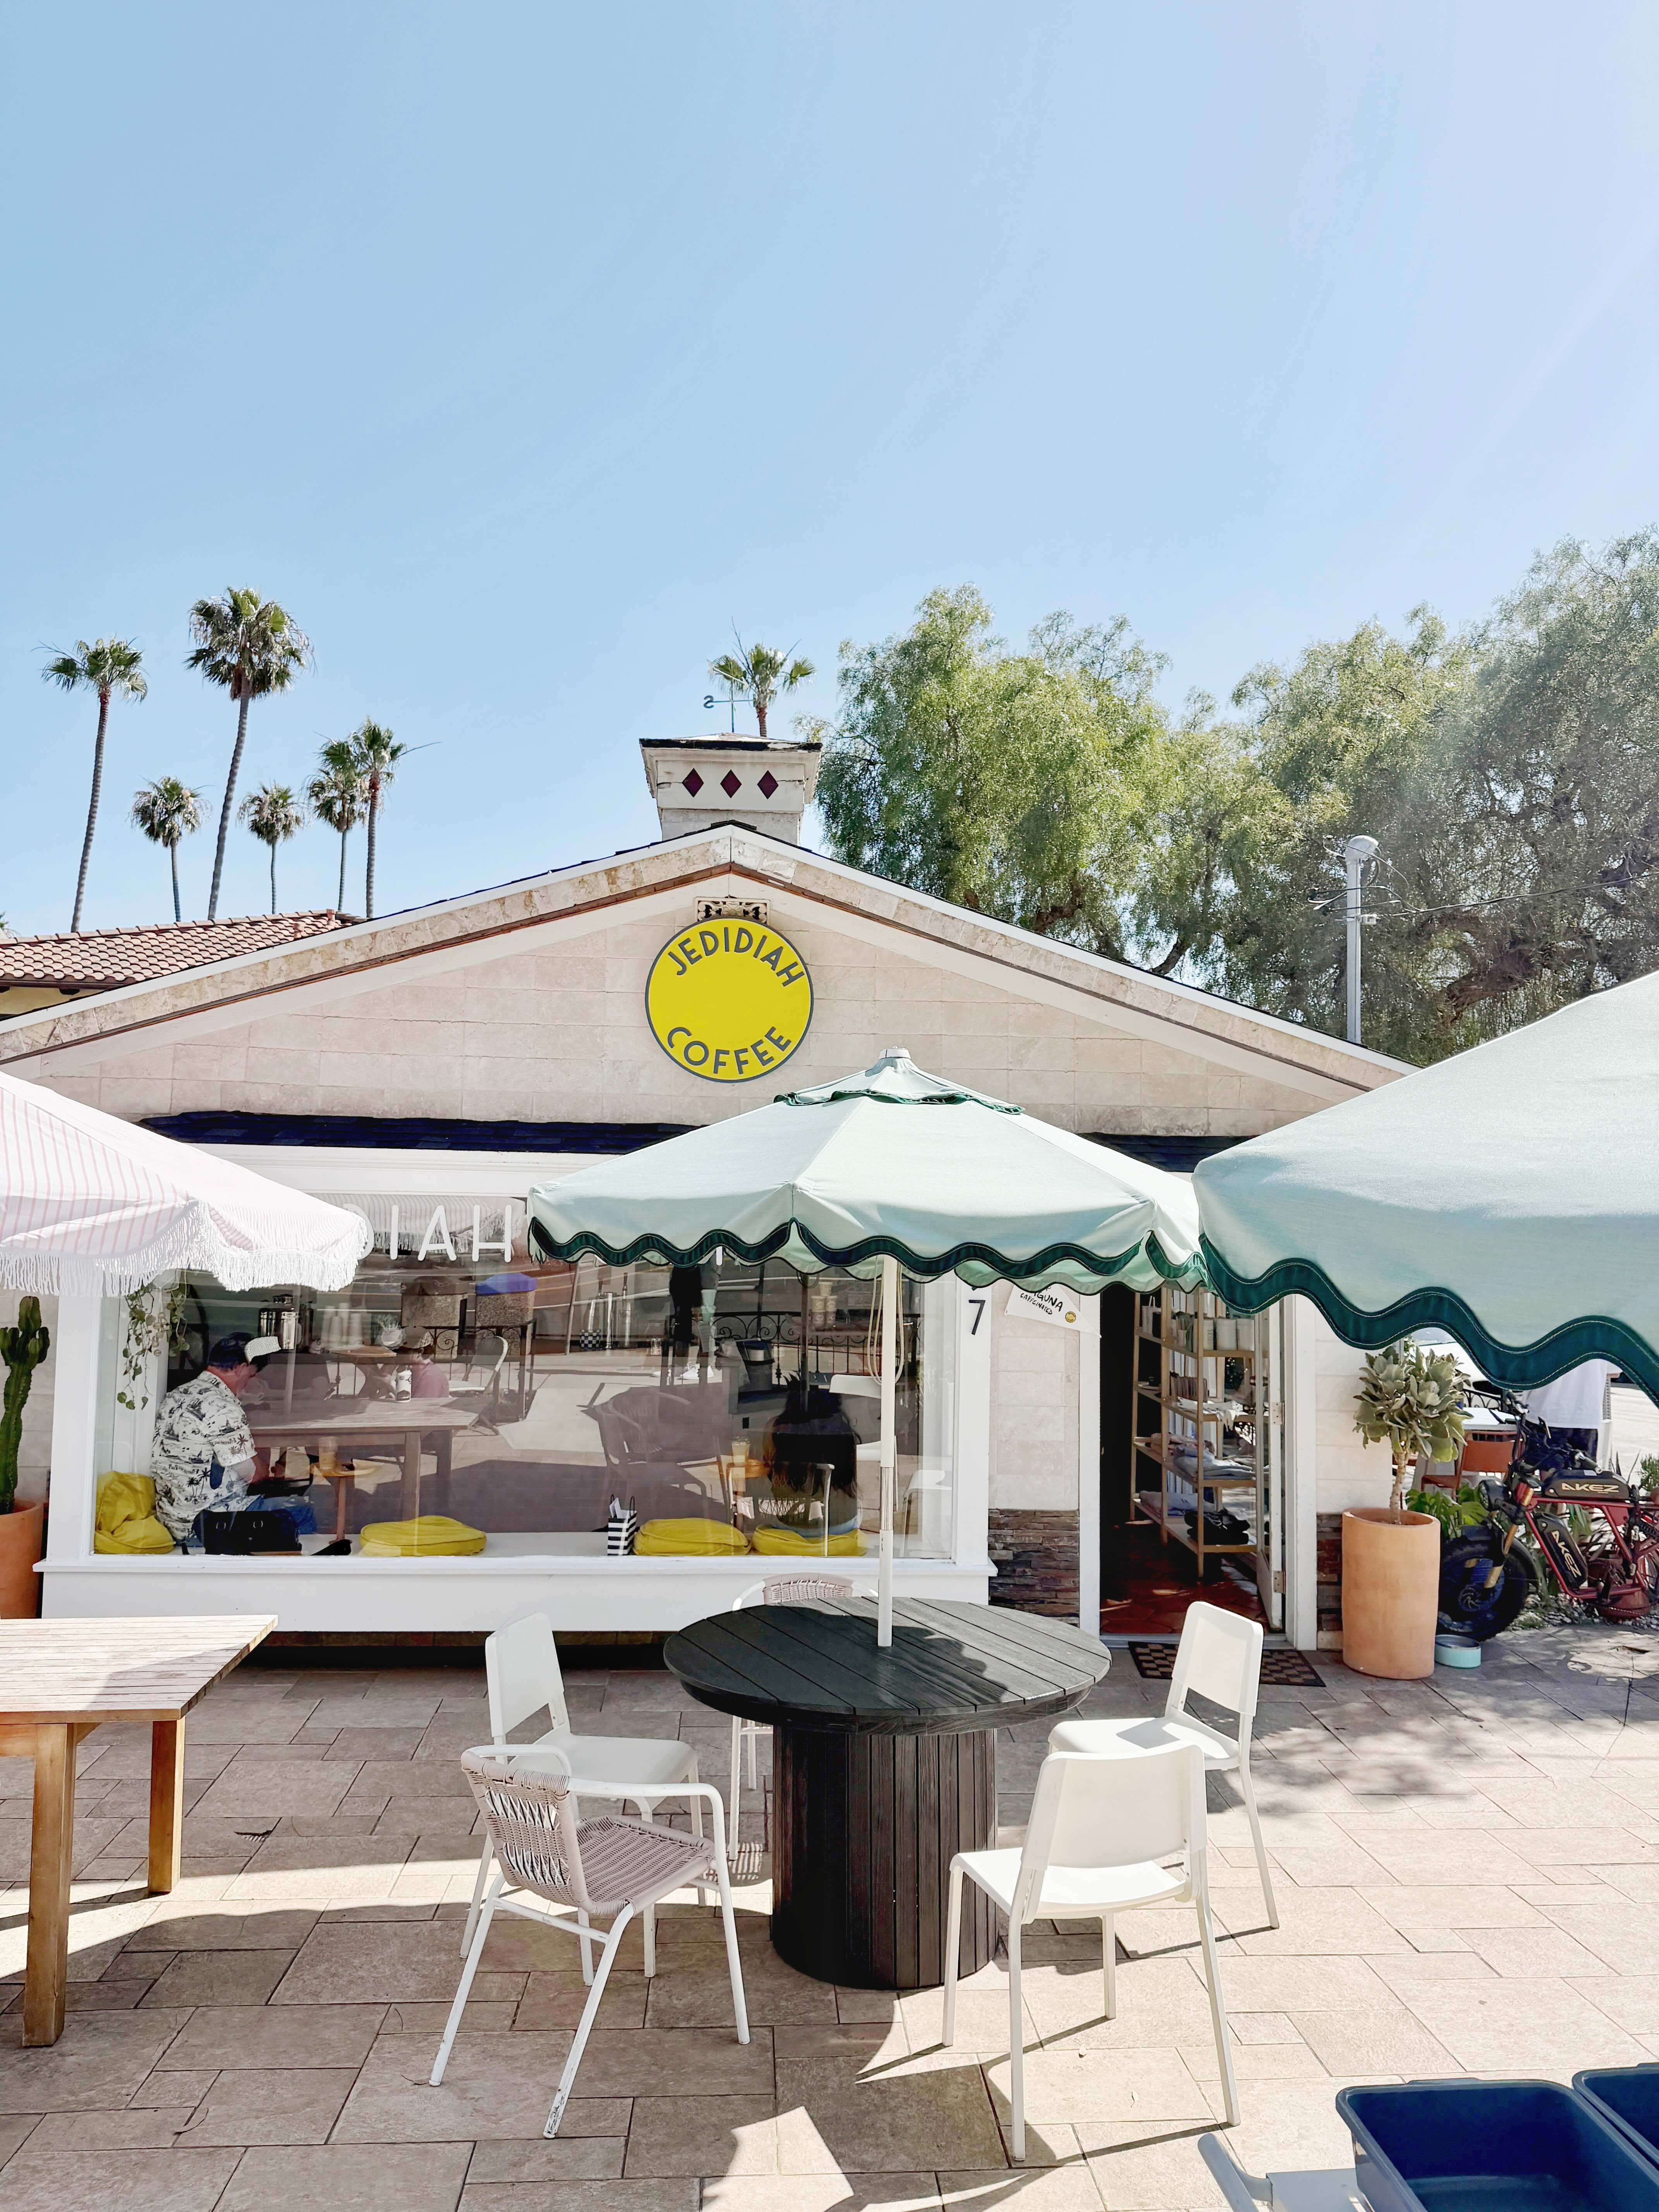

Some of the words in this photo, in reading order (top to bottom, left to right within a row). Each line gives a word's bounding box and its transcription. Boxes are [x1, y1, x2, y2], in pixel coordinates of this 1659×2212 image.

[668, 927, 805, 987] JEDIDIAH
[667, 1026, 792, 1075] COFFEE
[968, 1299, 986, 1336] 7
[1020, 1293, 1053, 1315] CAFFEINATED
